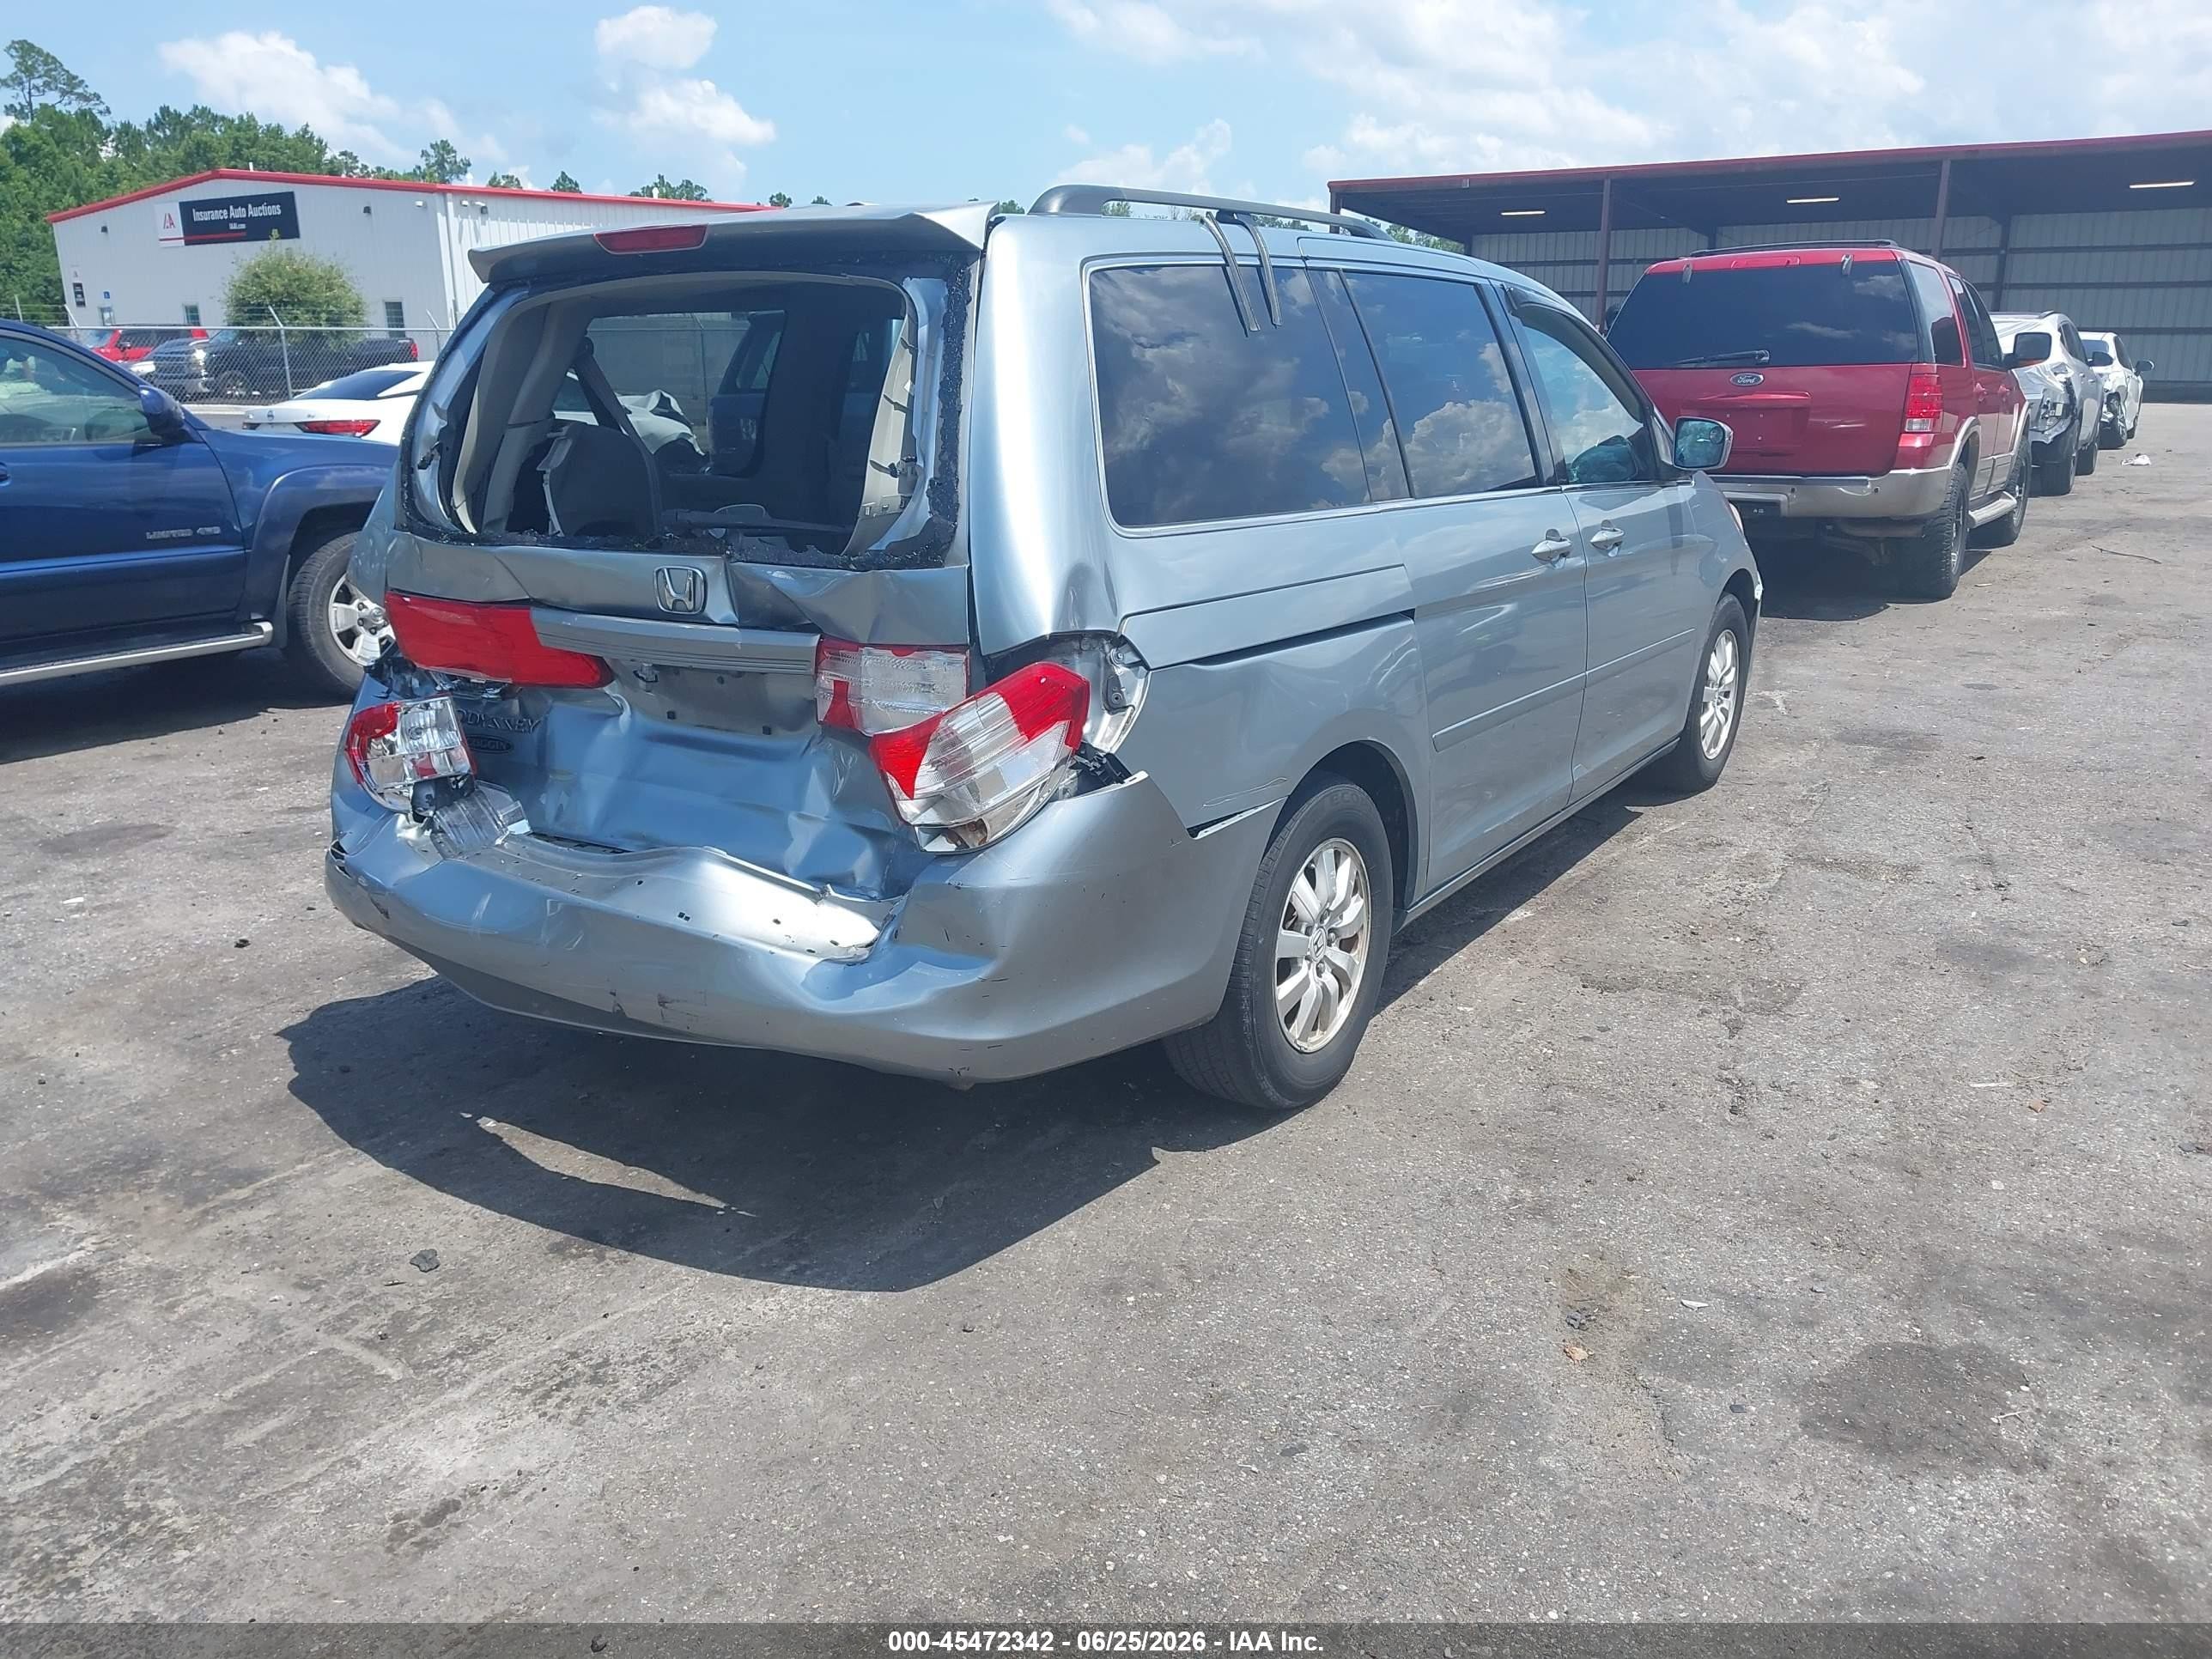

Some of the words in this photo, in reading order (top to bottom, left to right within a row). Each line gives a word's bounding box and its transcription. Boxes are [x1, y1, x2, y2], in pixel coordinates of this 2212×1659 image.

[192, 208, 228, 222] Insurance
[229, 204, 246, 218] Auto
[247, 202, 282, 217] Auctions
